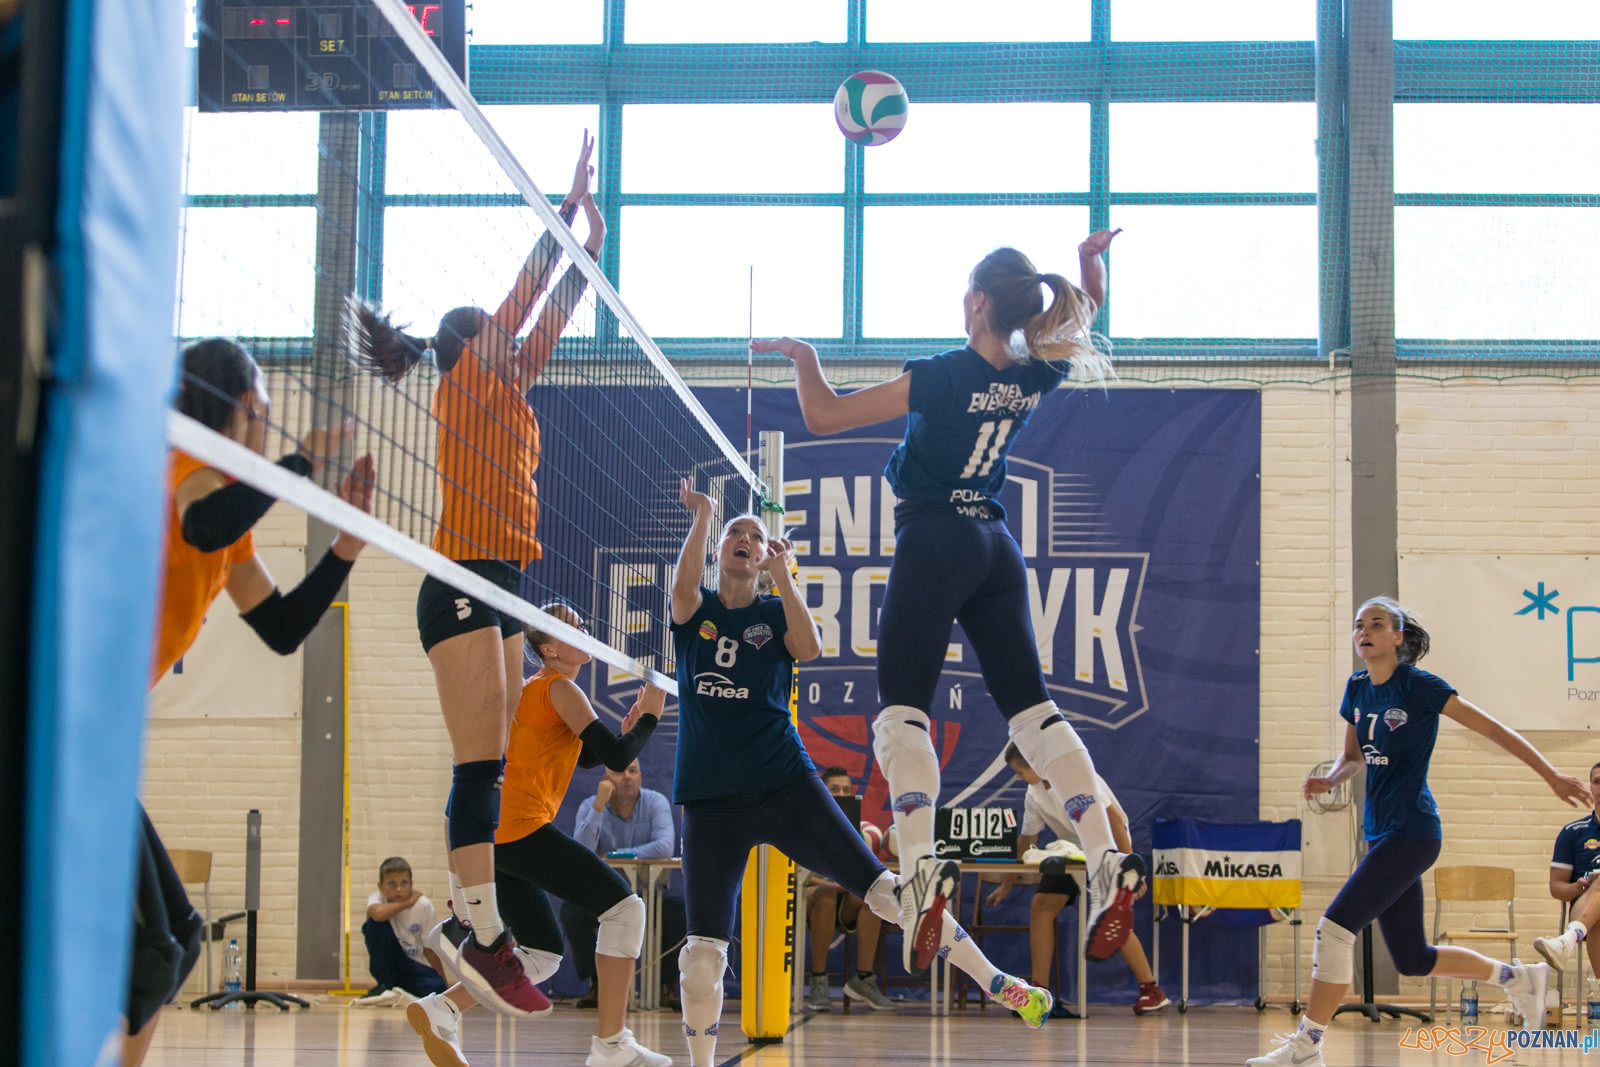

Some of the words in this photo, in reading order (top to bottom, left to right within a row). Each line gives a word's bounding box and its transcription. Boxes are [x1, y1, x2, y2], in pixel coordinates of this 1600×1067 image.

[319, 39, 345, 52] SET
[231, 92, 254, 103] STAN
[378, 90, 400, 101] STAN
[959, 419, 1014, 479] 11
[715, 635, 739, 668] 8
[696, 679, 749, 699] Enea
[1366, 713, 1379, 741] 7
